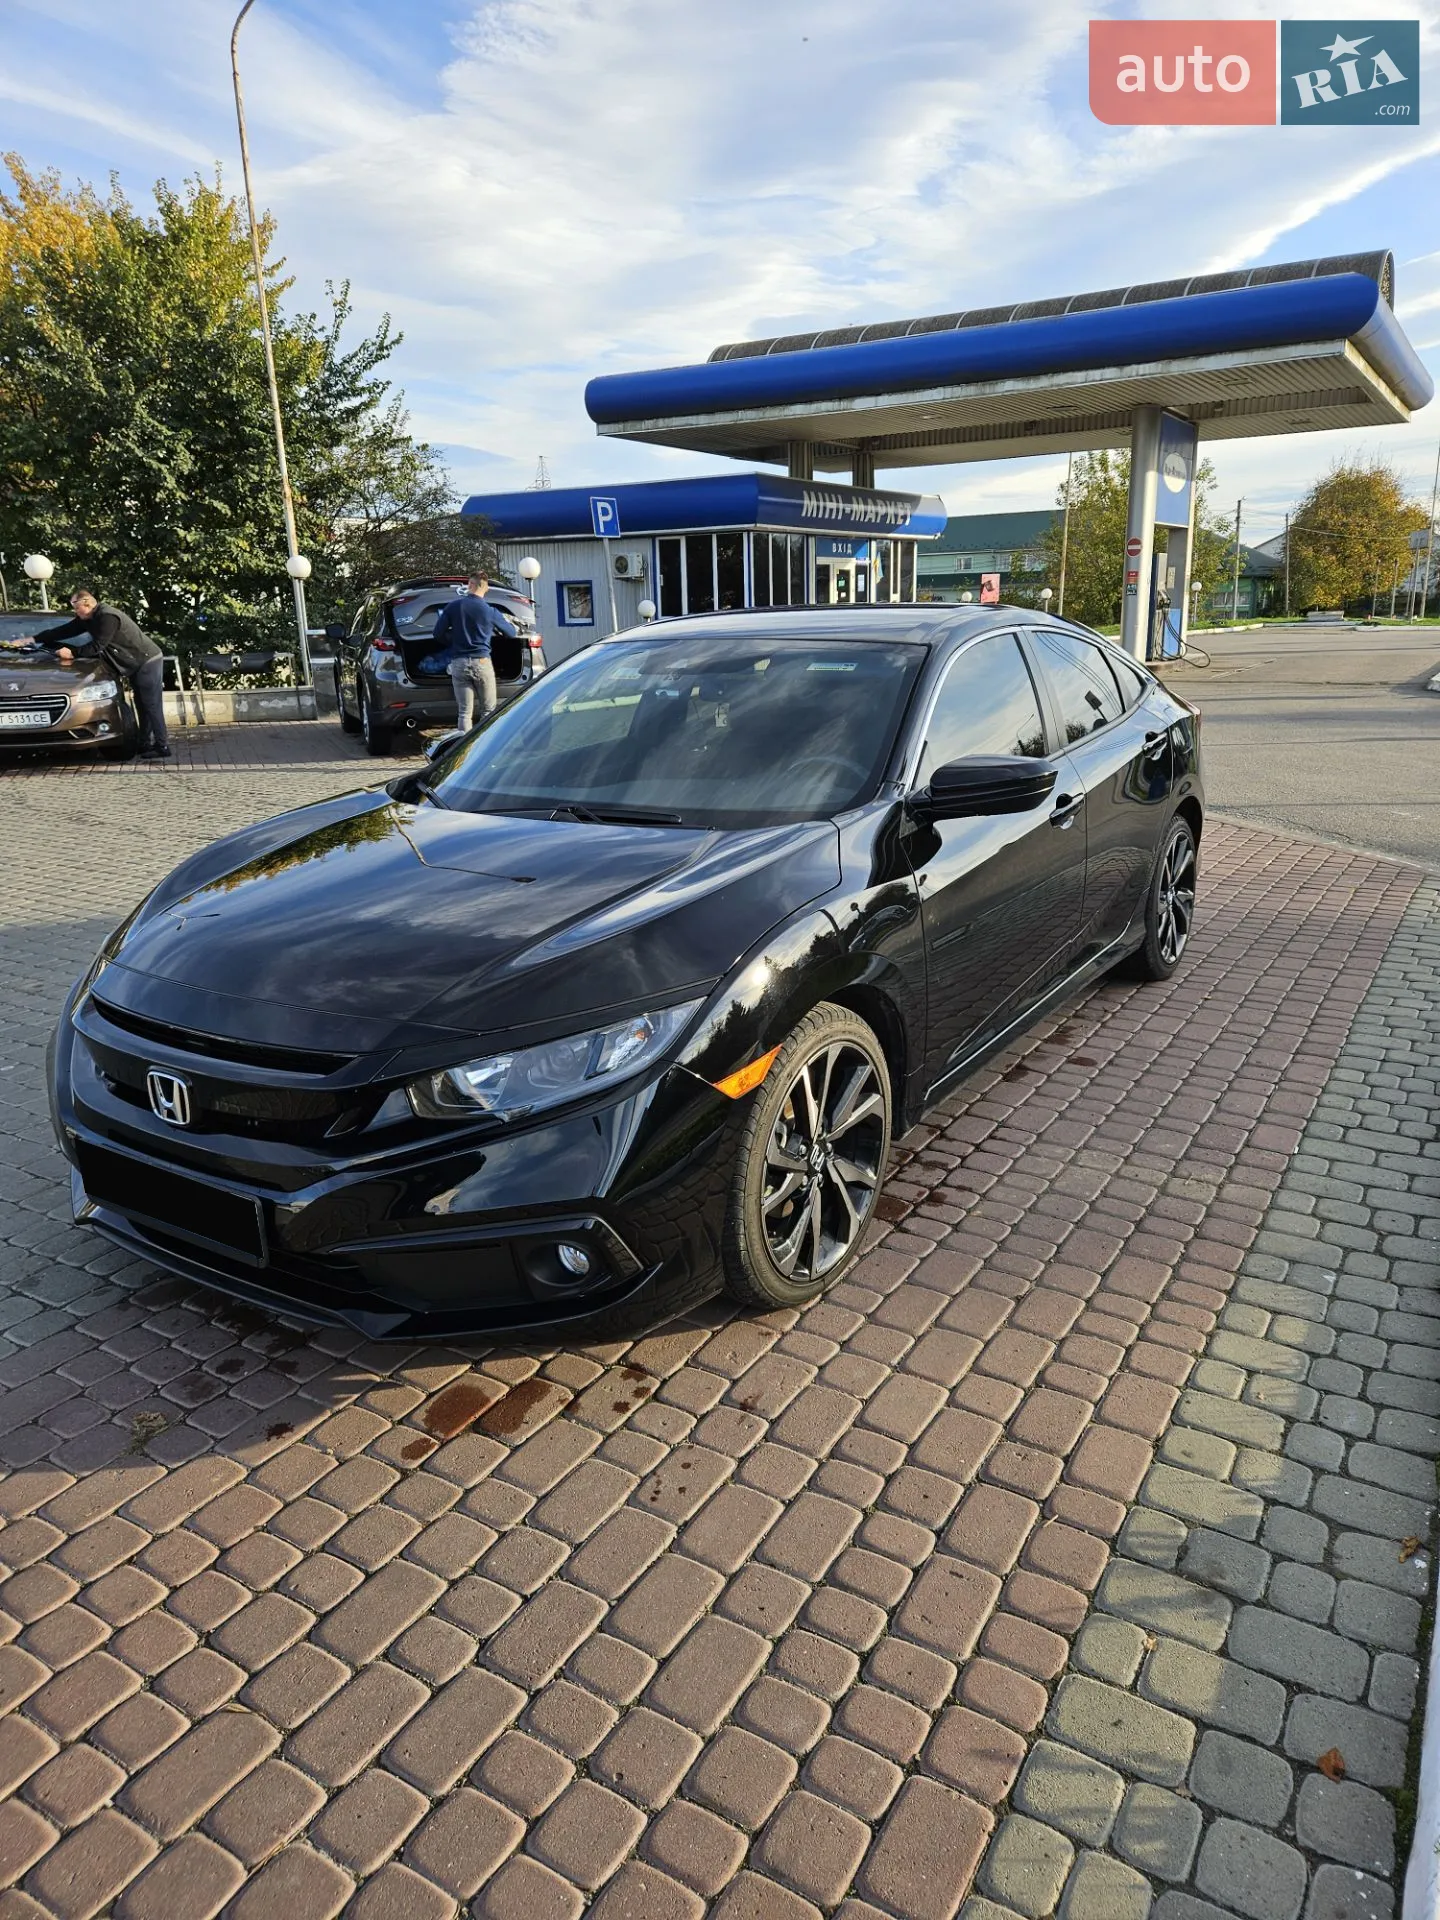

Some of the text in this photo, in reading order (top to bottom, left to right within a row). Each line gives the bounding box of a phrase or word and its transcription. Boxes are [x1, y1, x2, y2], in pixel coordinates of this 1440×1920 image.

[597, 501, 613, 533] P
[801, 490, 912, 526] МІНІ-МАРКЕТ
[832, 543, 853, 554] ВХІД
[8, 714, 31, 724] 5131
[33, 713, 48, 723] CE
